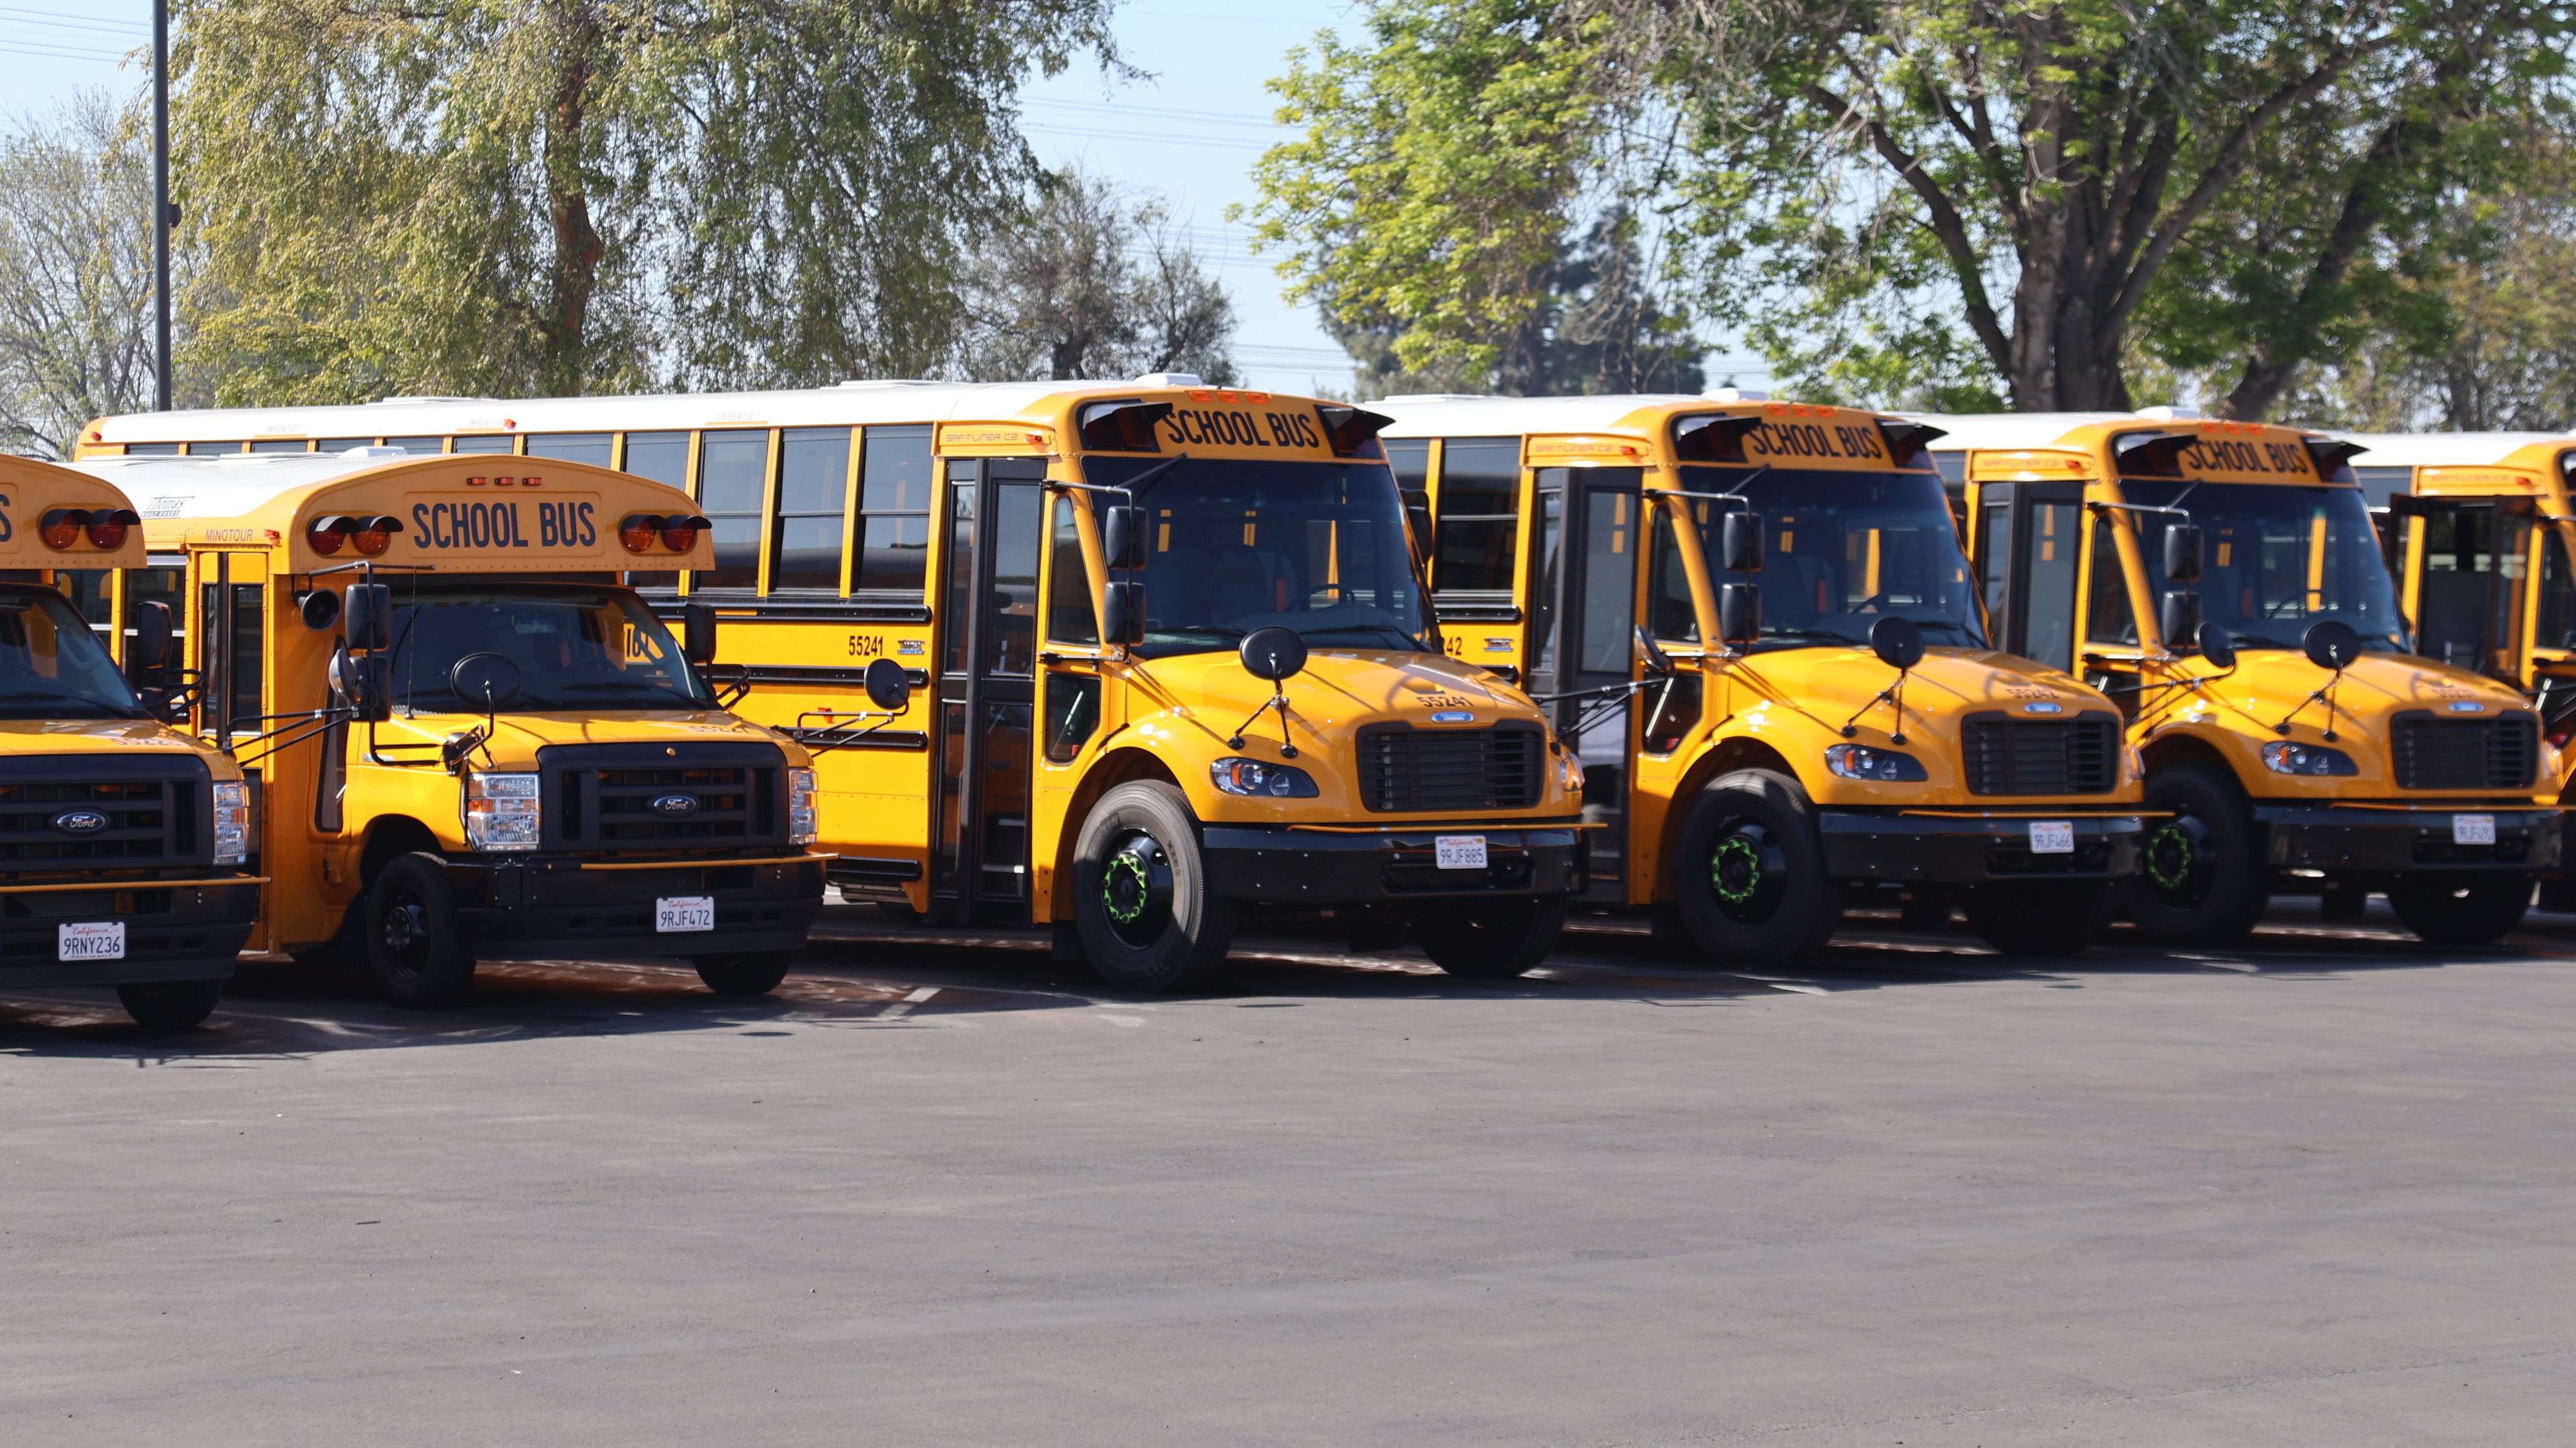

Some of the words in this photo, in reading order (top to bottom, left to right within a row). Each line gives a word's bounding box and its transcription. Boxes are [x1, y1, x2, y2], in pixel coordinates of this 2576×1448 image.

[1162, 410, 1271, 446] SCHOOL
[1265, 413, 1320, 448] BUS
[1748, 423, 1841, 457] SCHOOL
[1834, 426, 1883, 459] BUS
[2184, 440, 2271, 471] SCHOOL
[2264, 443, 2309, 474] BUS
[146, 496, 196, 510] Thomas
[413, 503, 528, 549] SCHOOL
[539, 502, 596, 547] BUS
[206, 529, 253, 542] MINOTOUR
[848, 635, 883, 656] 55241
[1416, 696, 1474, 707] 55241
[665, 798, 688, 810] Ford
[70, 815, 97, 827] Ford
[1441, 849, 1483, 864] 9RJF885
[669, 900, 703, 910] California
[661, 910, 710, 927] 9RJF472
[72, 926, 112, 936] California
[64, 936, 120, 955] 9RNY236
